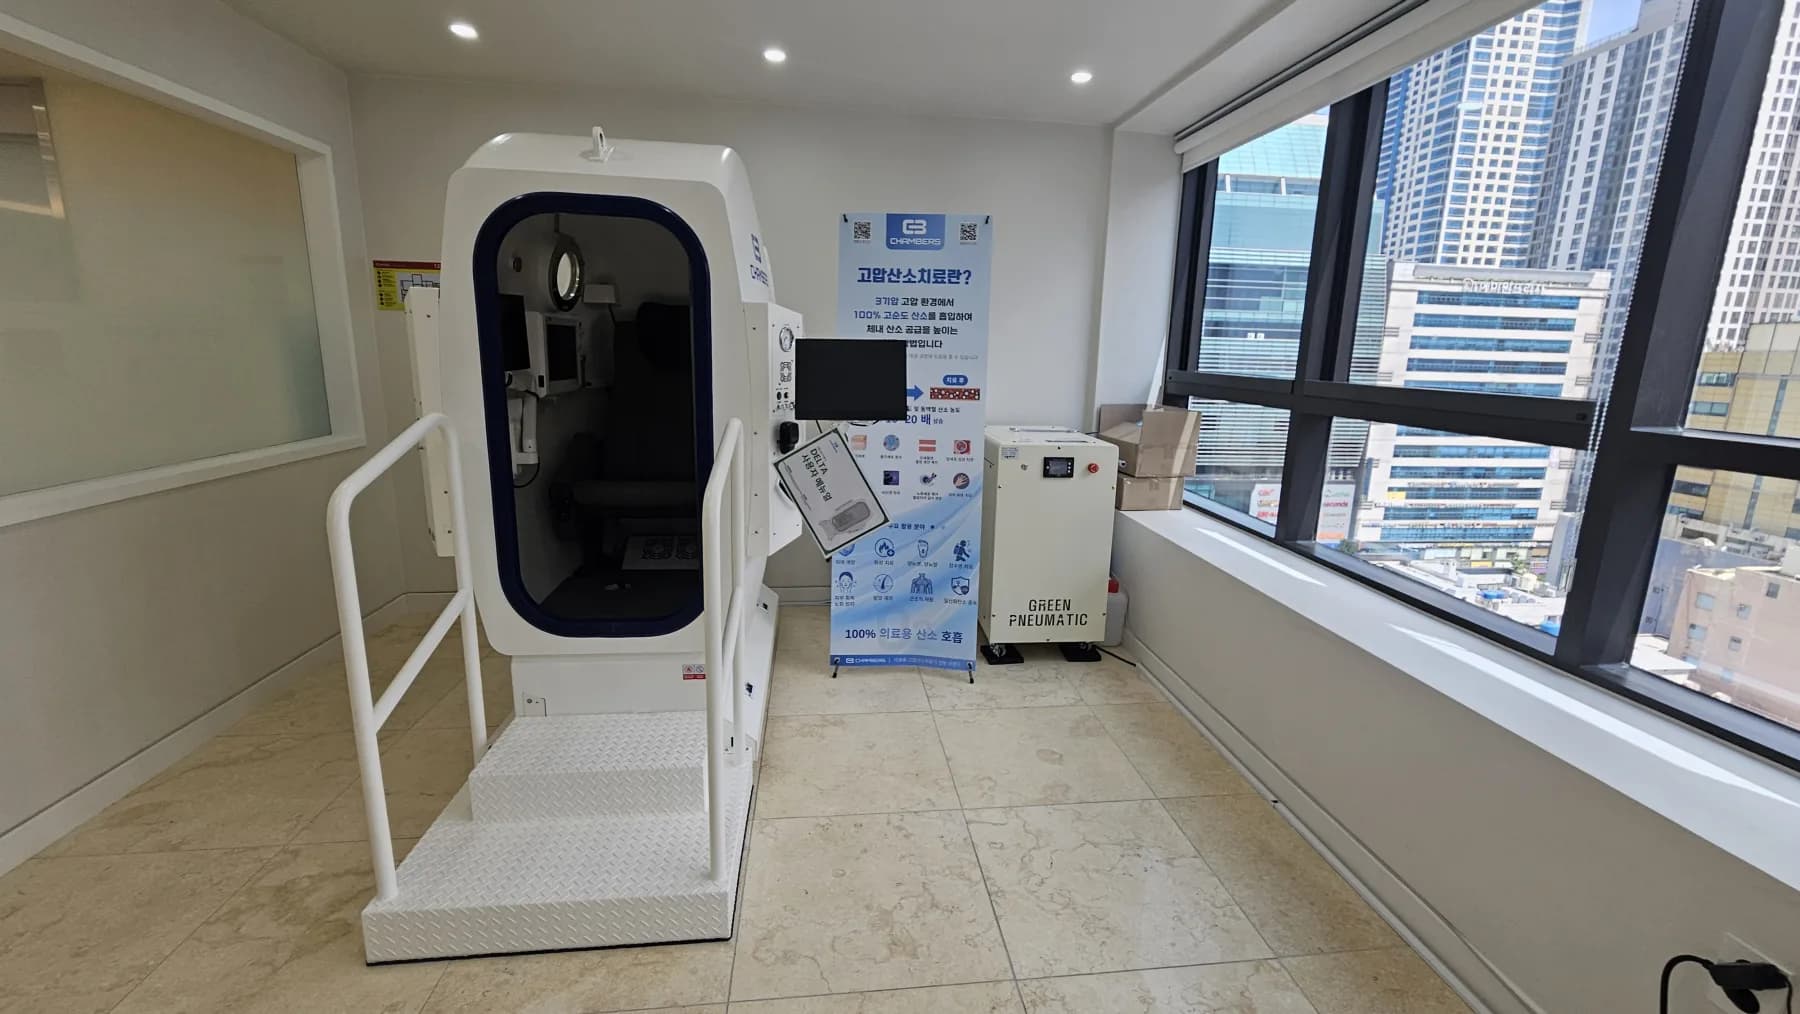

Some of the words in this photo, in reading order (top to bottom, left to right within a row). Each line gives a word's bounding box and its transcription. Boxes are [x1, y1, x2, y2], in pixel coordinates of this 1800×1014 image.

[889, 237, 941, 246] CHAMBERS
[857, 267, 972, 285] 고압산소치료란?
[875, 297, 899, 306] 3기압
[901, 297, 918, 307] 고압
[920, 297, 955, 308] 환경에서
[853, 310, 881, 319] 100%
[883, 311, 909, 320] 고순도
[911, 311, 936, 321] 산소를
[939, 312, 973, 321] 흡입하여
[866, 324, 884, 334] 체내
[886, 325, 903, 334] 산소
[905, 325, 930, 335] 공급을
[933, 326, 958, 335] 높이는
[906, 340, 943, 349] 법입니다
[921, 414, 931, 425] 배
[801, 454, 819, 478] 사용자
[810, 448, 829, 475] DELTA
[1028, 598, 1071, 612] GREEN
[1009, 613, 1088, 627] PNEUMATIC
[845, 629, 876, 639] 100%
[879, 628, 912, 640] 의료용
[916, 629, 938, 641] 산소
[941, 630, 963, 644] 호흡
